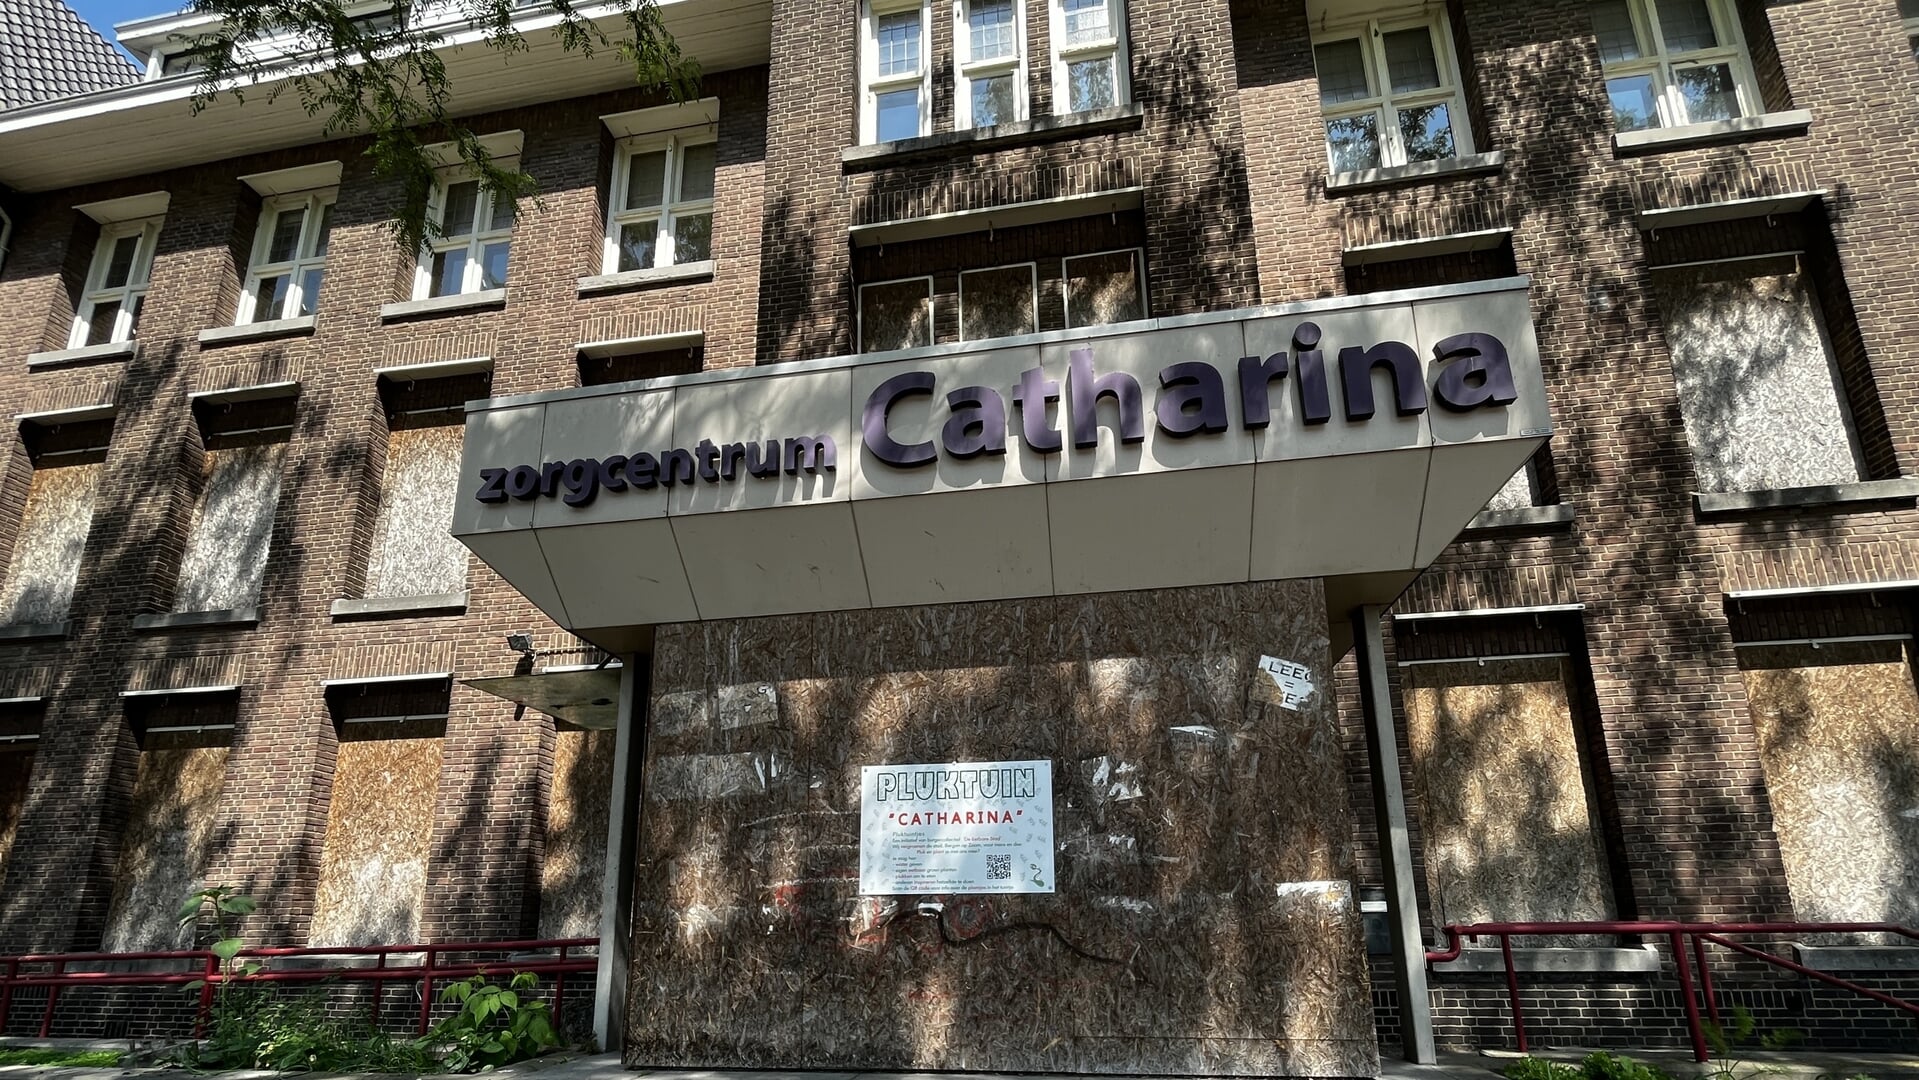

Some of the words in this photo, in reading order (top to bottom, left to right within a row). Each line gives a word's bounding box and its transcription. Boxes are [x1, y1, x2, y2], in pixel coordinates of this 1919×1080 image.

[475, 432, 837, 508] zorgcentrum
[861, 322, 1518, 469] Catharina
[877, 768, 1035, 801] PLUKTUIN
